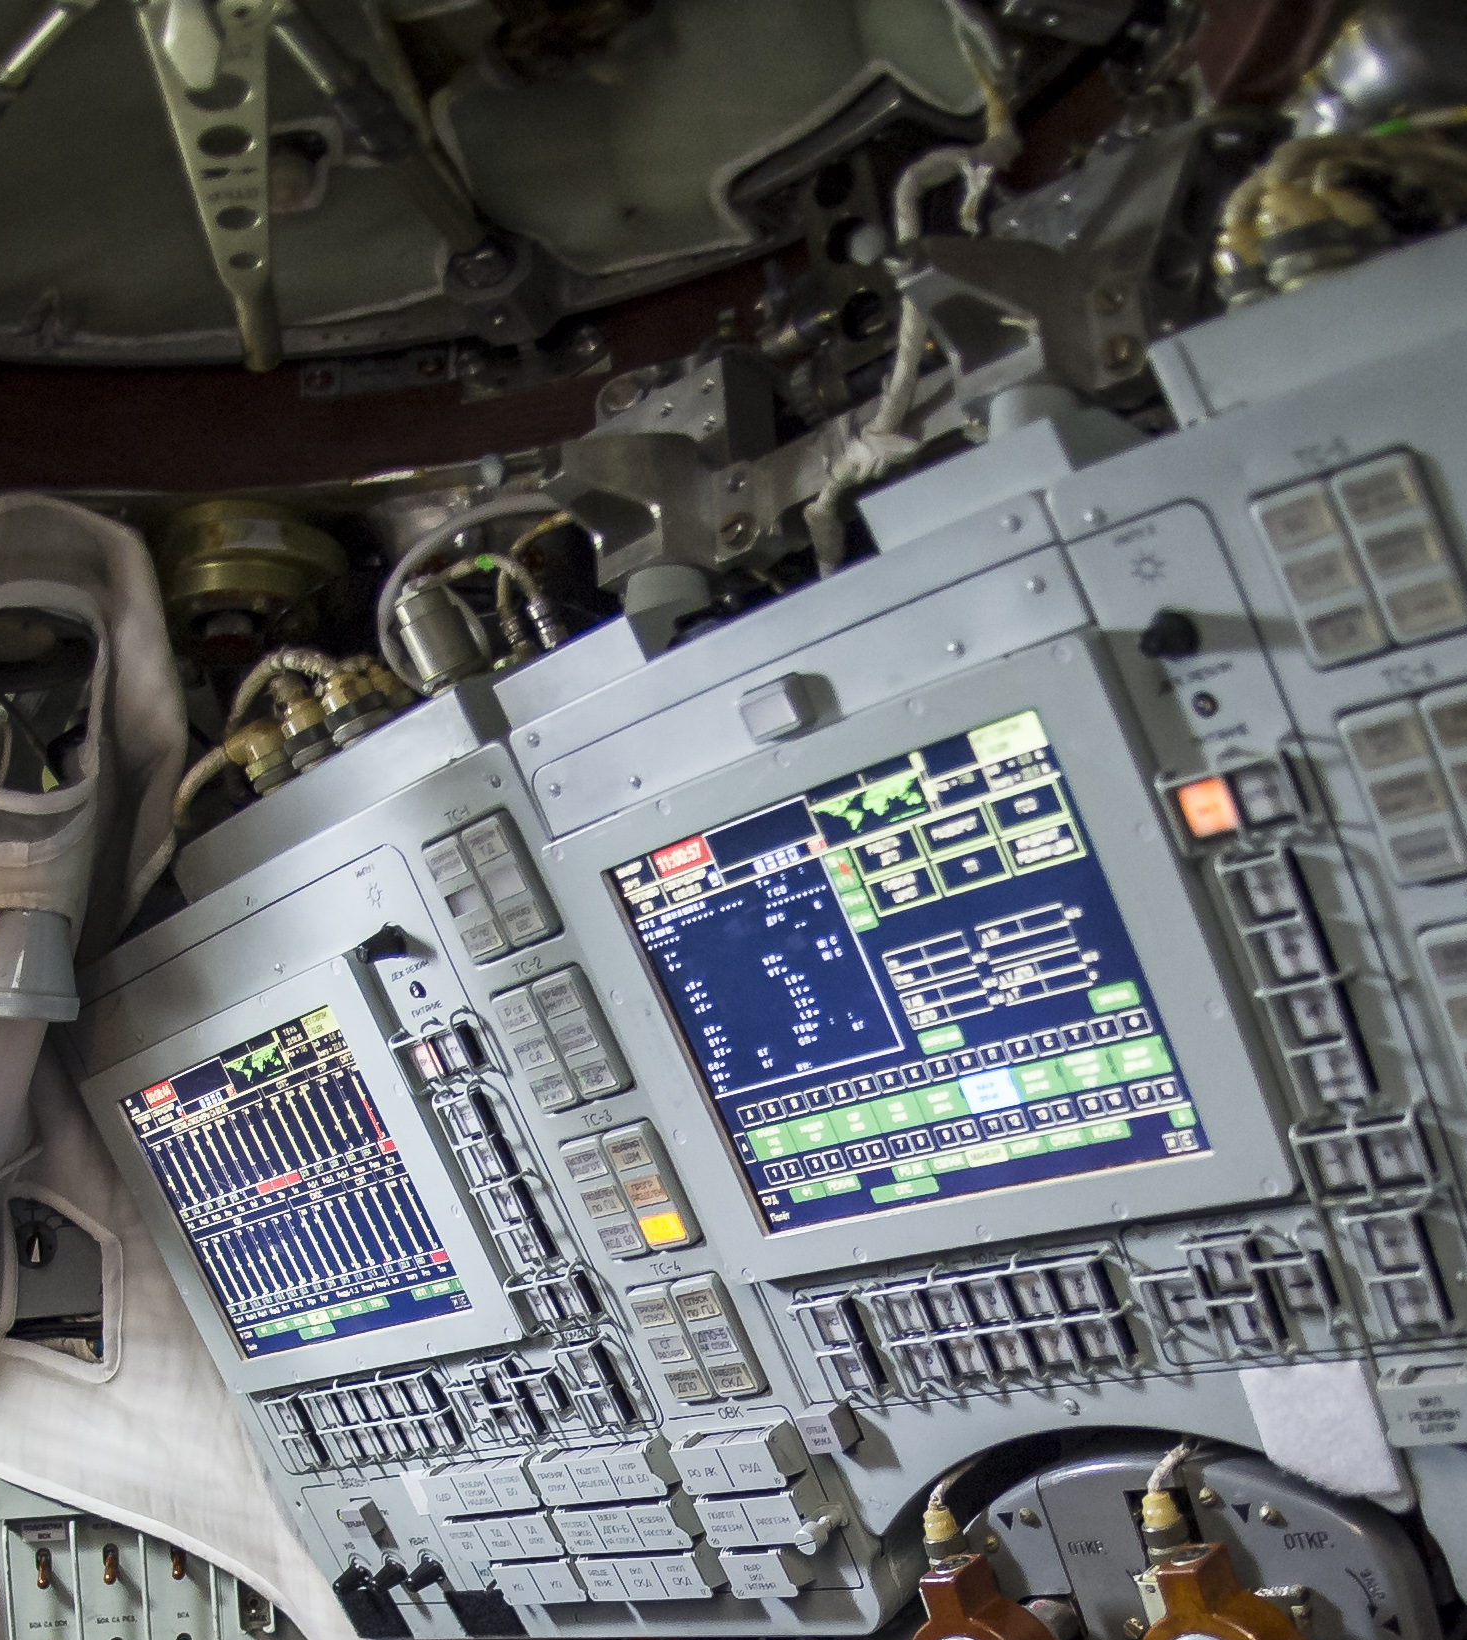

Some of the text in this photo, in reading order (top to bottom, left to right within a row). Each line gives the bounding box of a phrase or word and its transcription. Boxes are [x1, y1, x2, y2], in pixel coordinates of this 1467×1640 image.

[512, 958, 543, 976] ТС-2
[581, 1111, 612, 1129] ТС-3
[650, 1262, 681, 1276] ТС-4
[718, 1405, 744, 1420] ОВК
[490, 1529, 502, 1537] ТД
[524, 1525, 538, 1534] ТД
[1067, 1540, 1108, 1555] ОТКР.
[1284, 1531, 1334, 1550] ОТКР.
[672, 1576, 693, 1587] СКД
